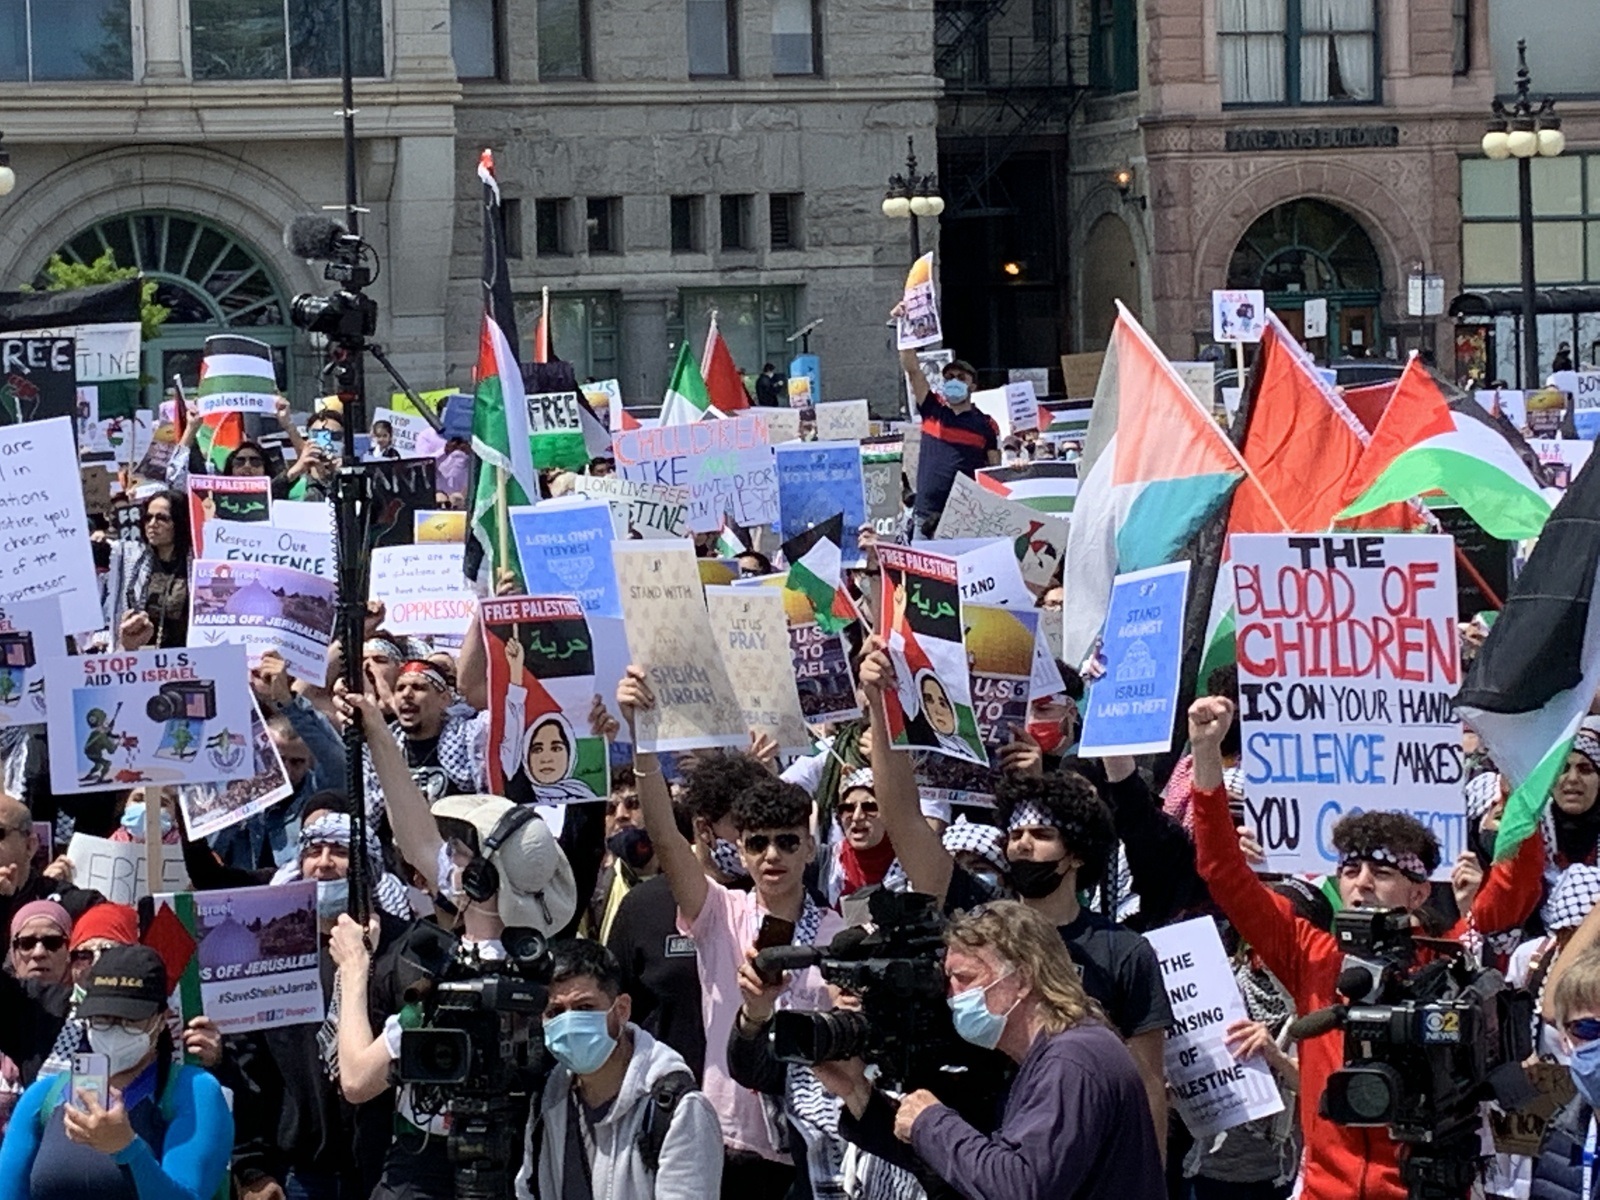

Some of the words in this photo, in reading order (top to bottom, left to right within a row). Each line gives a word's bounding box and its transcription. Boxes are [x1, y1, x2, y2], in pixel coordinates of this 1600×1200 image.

[1320, 127, 1393, 146] BUILDING
[2, 340, 72, 375] REE
[527, 394, 580, 432] FREE
[2, 440, 34, 456] are
[615, 415, 770, 465] CHILDREN
[13, 465, 31, 476] in
[748, 467, 774, 487] FOR
[0, 490, 50, 507] ations
[584, 477, 617, 495] LONG
[619, 480, 649, 499] LIVE
[651, 484, 690, 504] FREE
[43, 508, 70, 527] you
[689, 501, 708, 520] IN
[3, 532, 51, 552] chosen
[56, 527, 76, 539] the
[1289, 536, 1385, 569] THE
[12, 557, 26, 575] of
[33, 552, 56, 567] the
[220, 567, 229, 578] &
[879, 548, 907, 568] FREE
[905, 552, 958, 580] PALESTINE
[630, 585, 662, 599] STAND
[664, 585, 692, 599] WITH
[961, 576, 996, 599] TAND
[1233, 563, 1355, 622] BLOOD
[1381, 562, 1438, 617] OF
[392, 599, 475, 624] OPPRESSOR
[484, 604, 519, 621] FREE
[521, 600, 582, 618] PALESTINE
[910, 583, 956, 619] حرية
[731, 618, 746, 629] LET
[749, 618, 763, 630] US
[1126, 607, 1161, 623] STAND
[194, 614, 235, 625] HANDS
[239, 614, 264, 625] OFF
[265, 616, 331, 644] JERUSALEM
[728, 629, 767, 649] PRAY
[1117, 620, 1163, 638] AGAINST
[530, 630, 588, 659] حرية
[799, 644, 824, 660] TO
[1236, 616, 1457, 684] CHILDREN
[84, 656, 138, 674] STOP
[155, 653, 197, 668] U.S.
[651, 663, 710, 684] SHEIKH
[85, 674, 112, 687] AID
[117, 672, 137, 685] TO
[141, 667, 199, 682] ISRAEL
[1115, 684, 1155, 699] ISRAELI
[975, 702, 1003, 720] TO
[1097, 702, 1129, 718] LAND
[1131, 700, 1167, 715] THEFT
[1241, 682, 1283, 722] IS
[1286, 683, 1324, 721] ON
[1330, 685, 1392, 723] YOUR
[1246, 732, 1386, 785] SILENCE
[1393, 742, 1463, 785] MAKES
[1245, 797, 1300, 850] YOU
[216, 964, 242, 980] OFF
[244, 953, 318, 975] JERUSALEM
[1160, 953, 1194, 975] THE
[218, 980, 318, 1004] #SaveSheikhJarrah
[1170, 983, 1198, 1004] NIC
[1165, 1007, 1224, 1039] ANSING
[1444, 1012, 1460, 1031] 2
[1425, 1031, 1458, 1042] NEWS
[1179, 1047, 1199, 1066] OF
